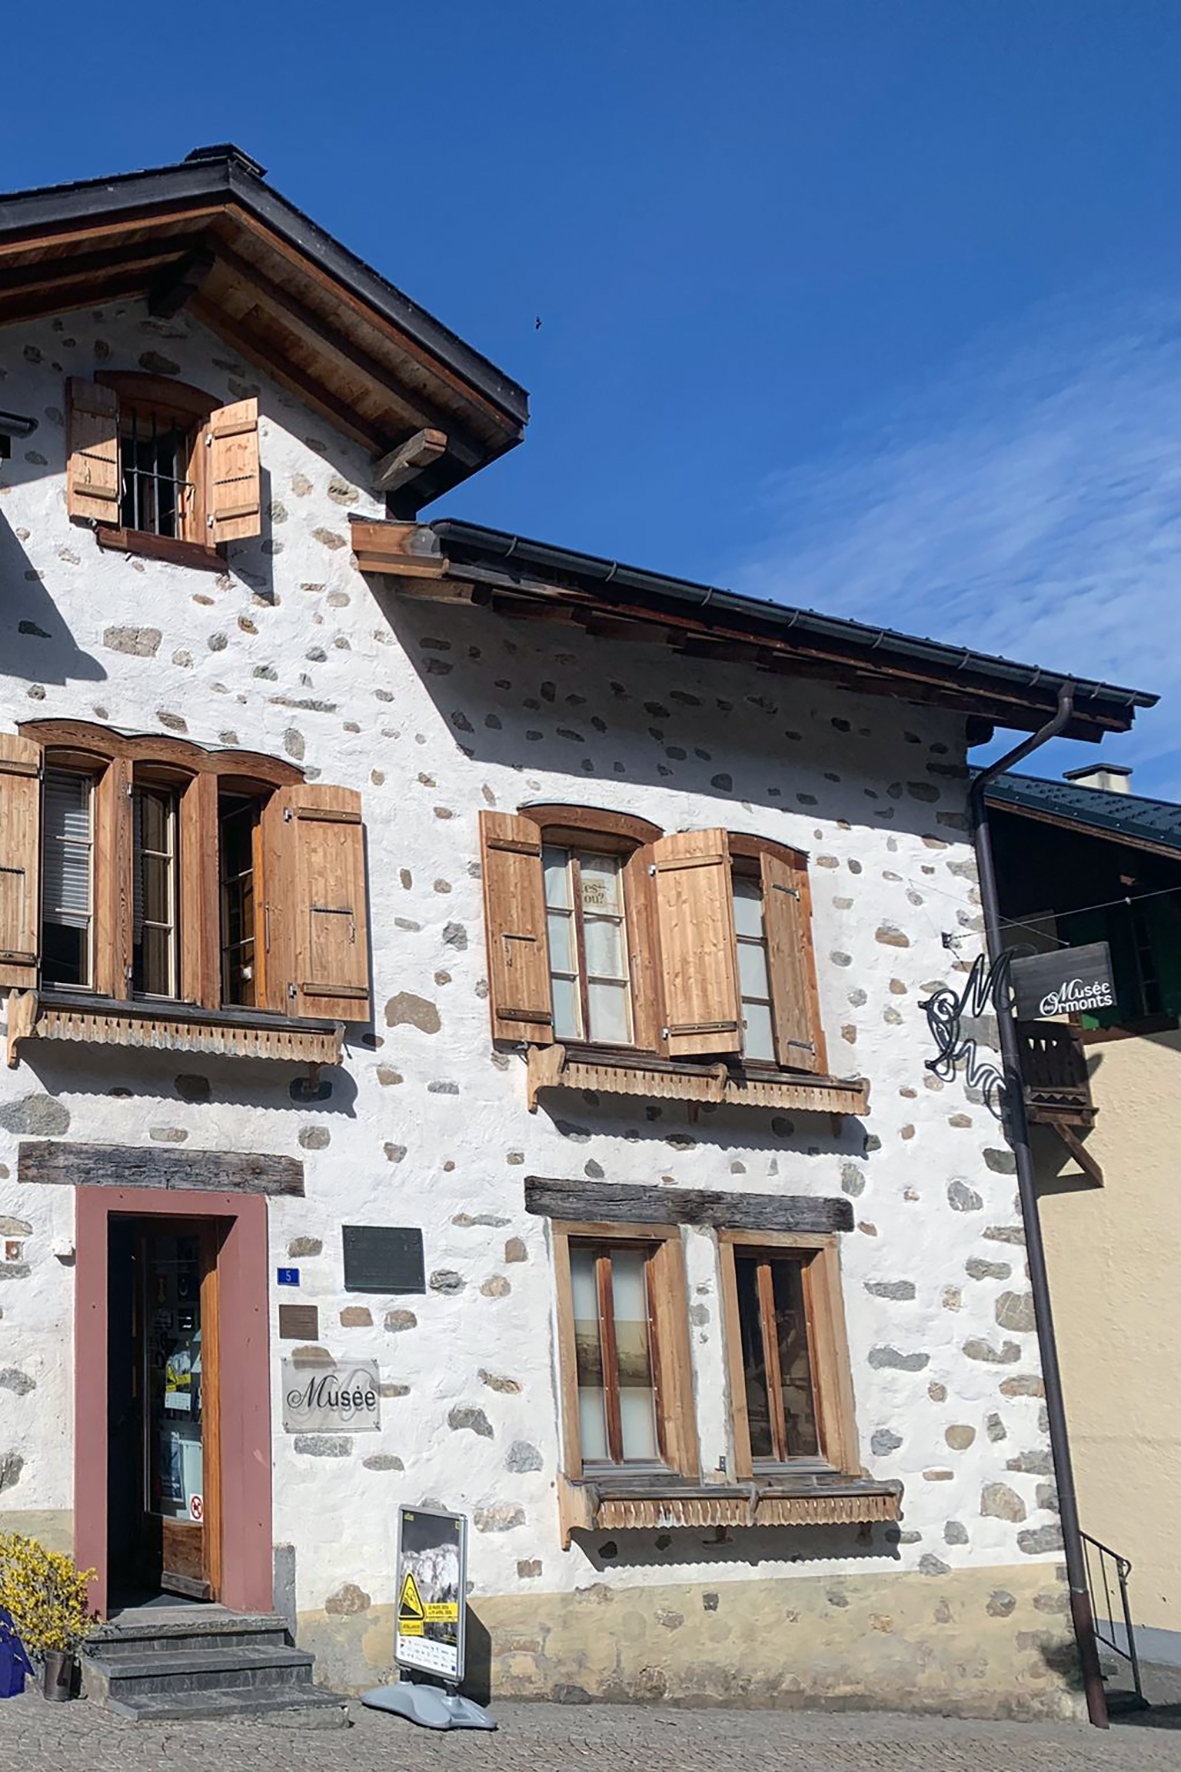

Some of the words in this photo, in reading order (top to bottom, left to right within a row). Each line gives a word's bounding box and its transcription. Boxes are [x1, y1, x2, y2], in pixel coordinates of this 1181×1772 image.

[1048, 978, 1111, 1003] Musée
[1040, 994, 1113, 1016] Ormonts
[285, 1270, 292, 1282] 5
[287, 1375, 375, 1409] Musée
